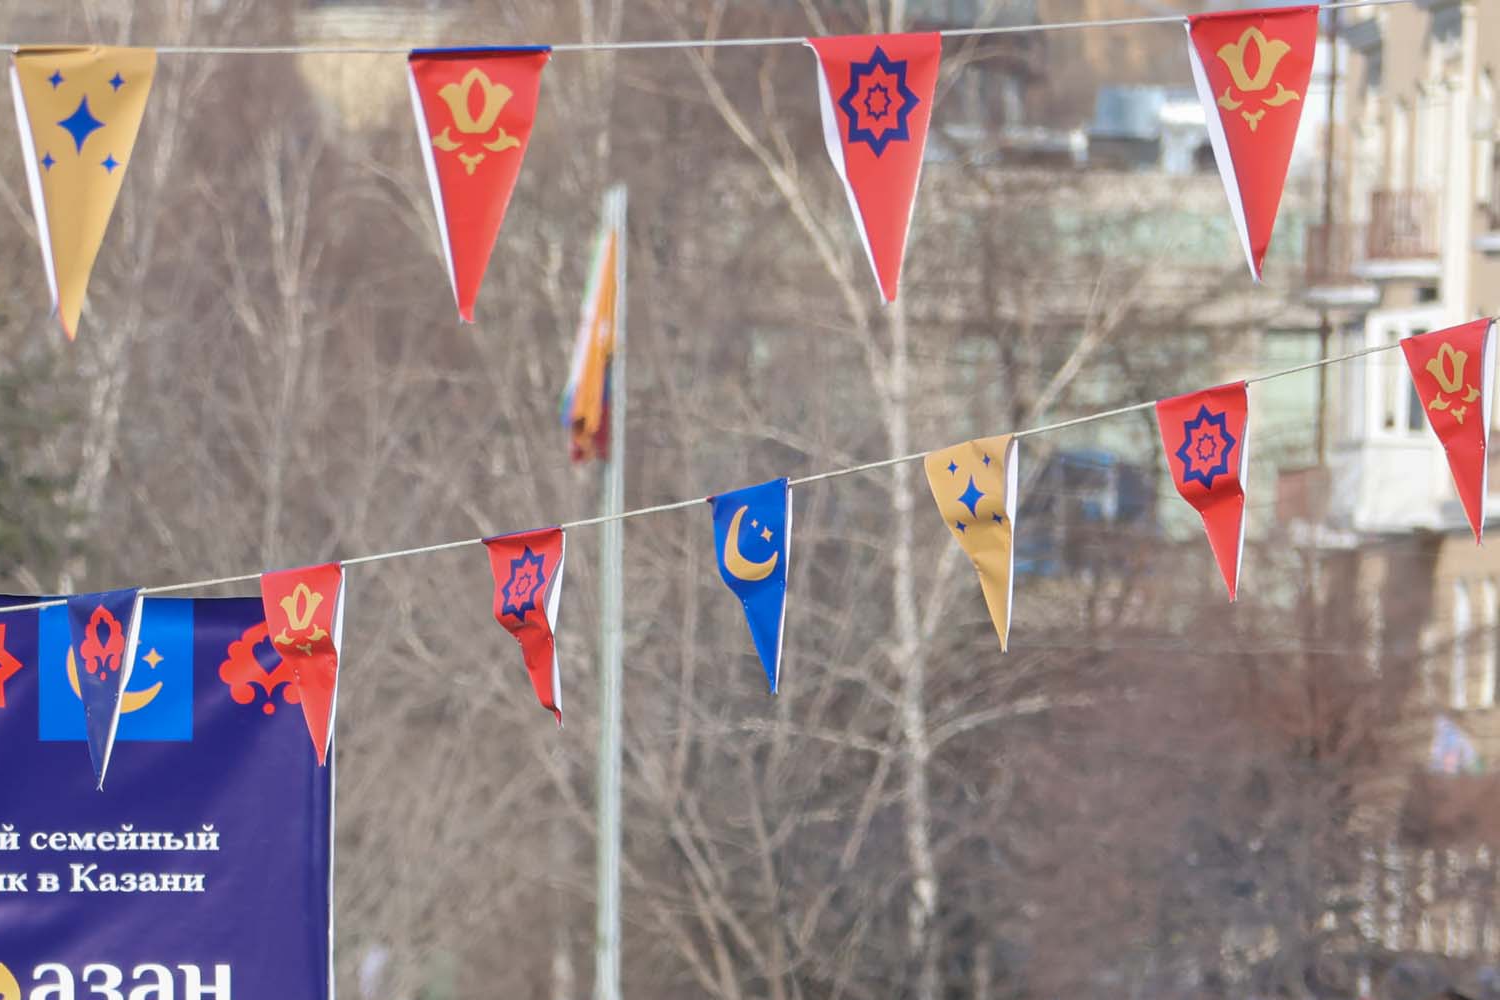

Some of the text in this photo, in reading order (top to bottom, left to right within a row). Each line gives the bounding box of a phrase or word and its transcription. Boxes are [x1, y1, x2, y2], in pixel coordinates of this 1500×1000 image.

[30, 823, 220, 851] семейный
[37, 873, 60, 892] в
[69, 863, 205, 892] Казани
